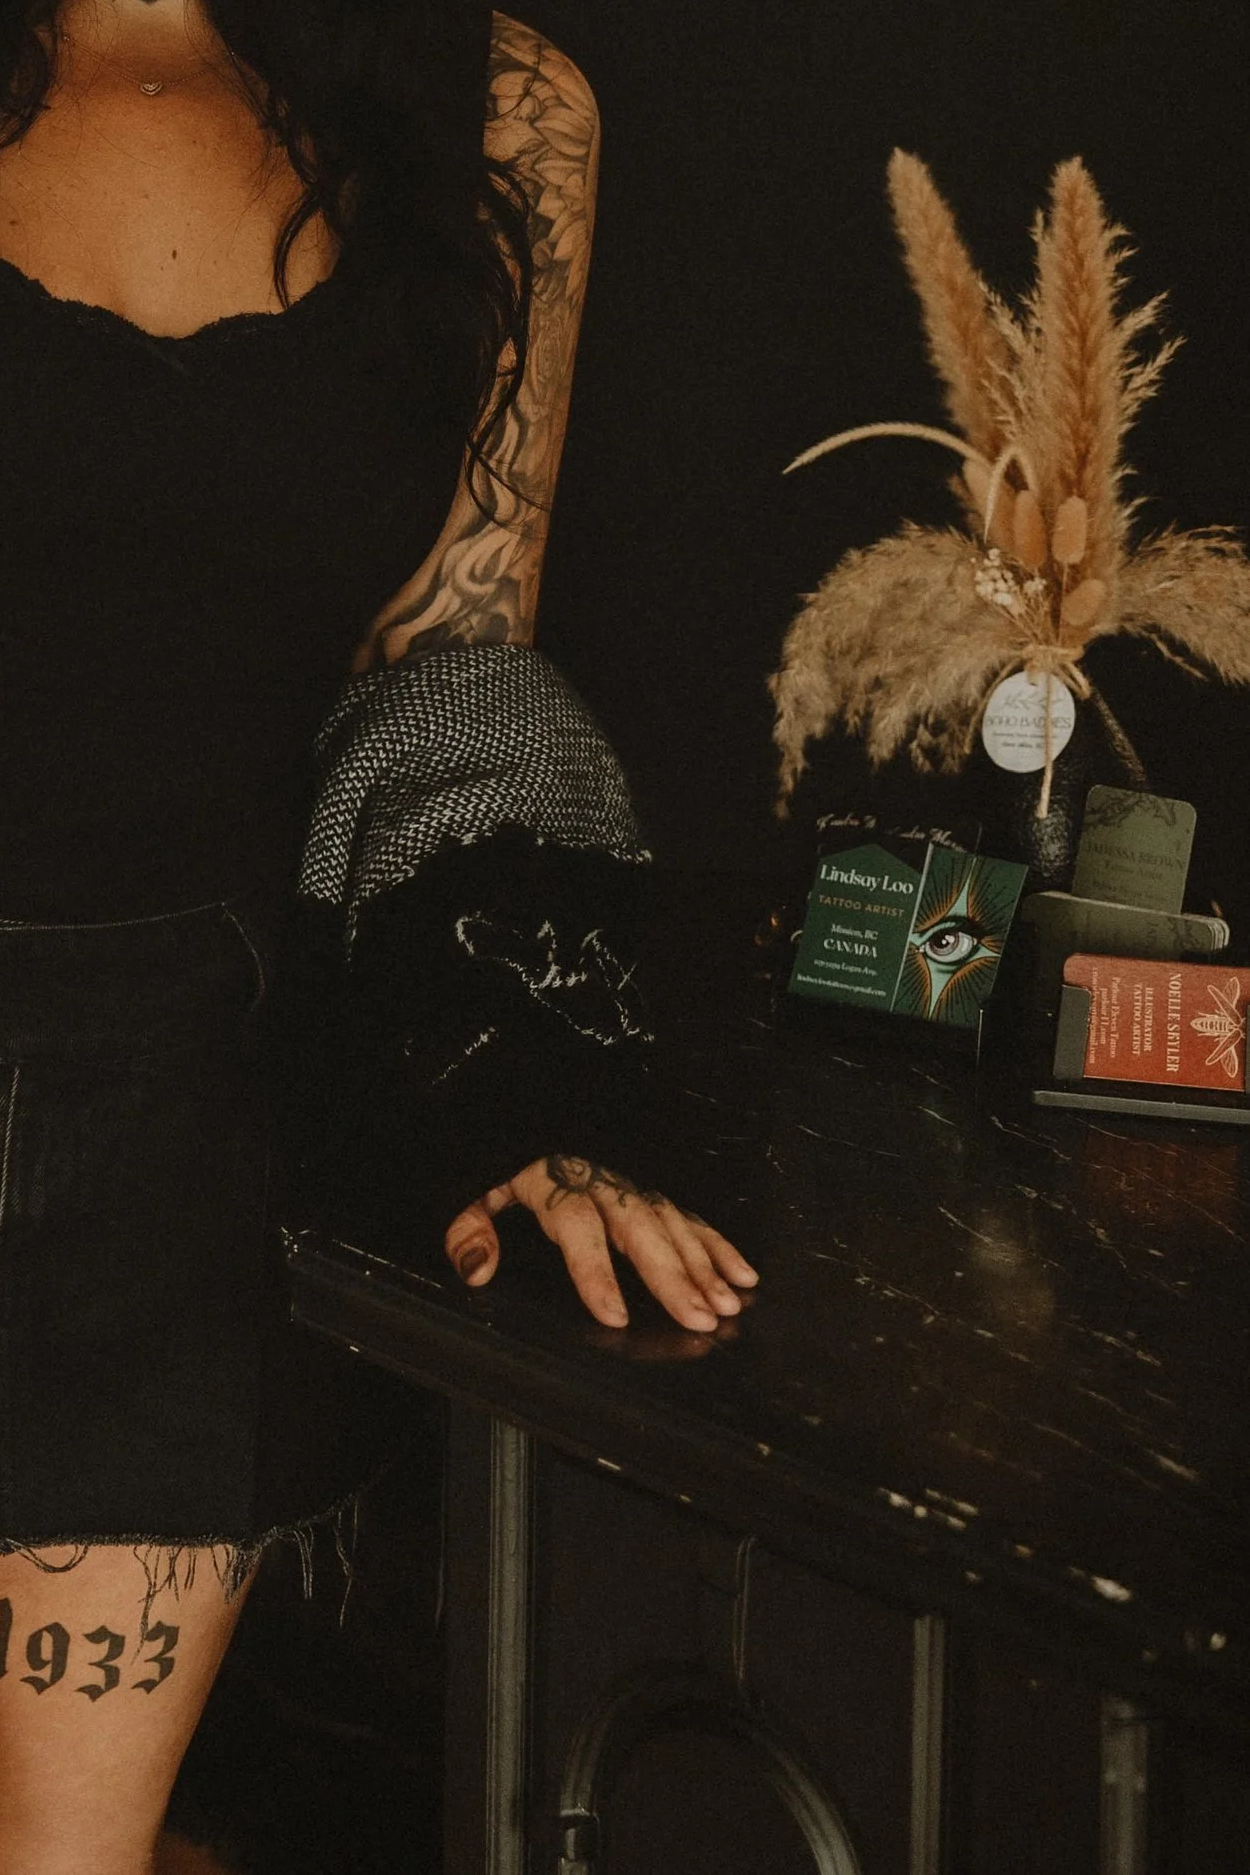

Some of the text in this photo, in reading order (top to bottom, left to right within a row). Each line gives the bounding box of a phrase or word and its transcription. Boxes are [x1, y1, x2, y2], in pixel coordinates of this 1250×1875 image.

[820, 864, 914, 894] Lindsay Loo
[818, 894, 904, 917] TATTOO ARTIST
[823, 938, 878, 958] CANADA
[1132, 983, 1143, 1055] TATTOO ARTIST
[1143, 987, 1154, 1051] ILLUSTRATOR
[1166, 973, 1182, 1072] NOELLE SKYLER
